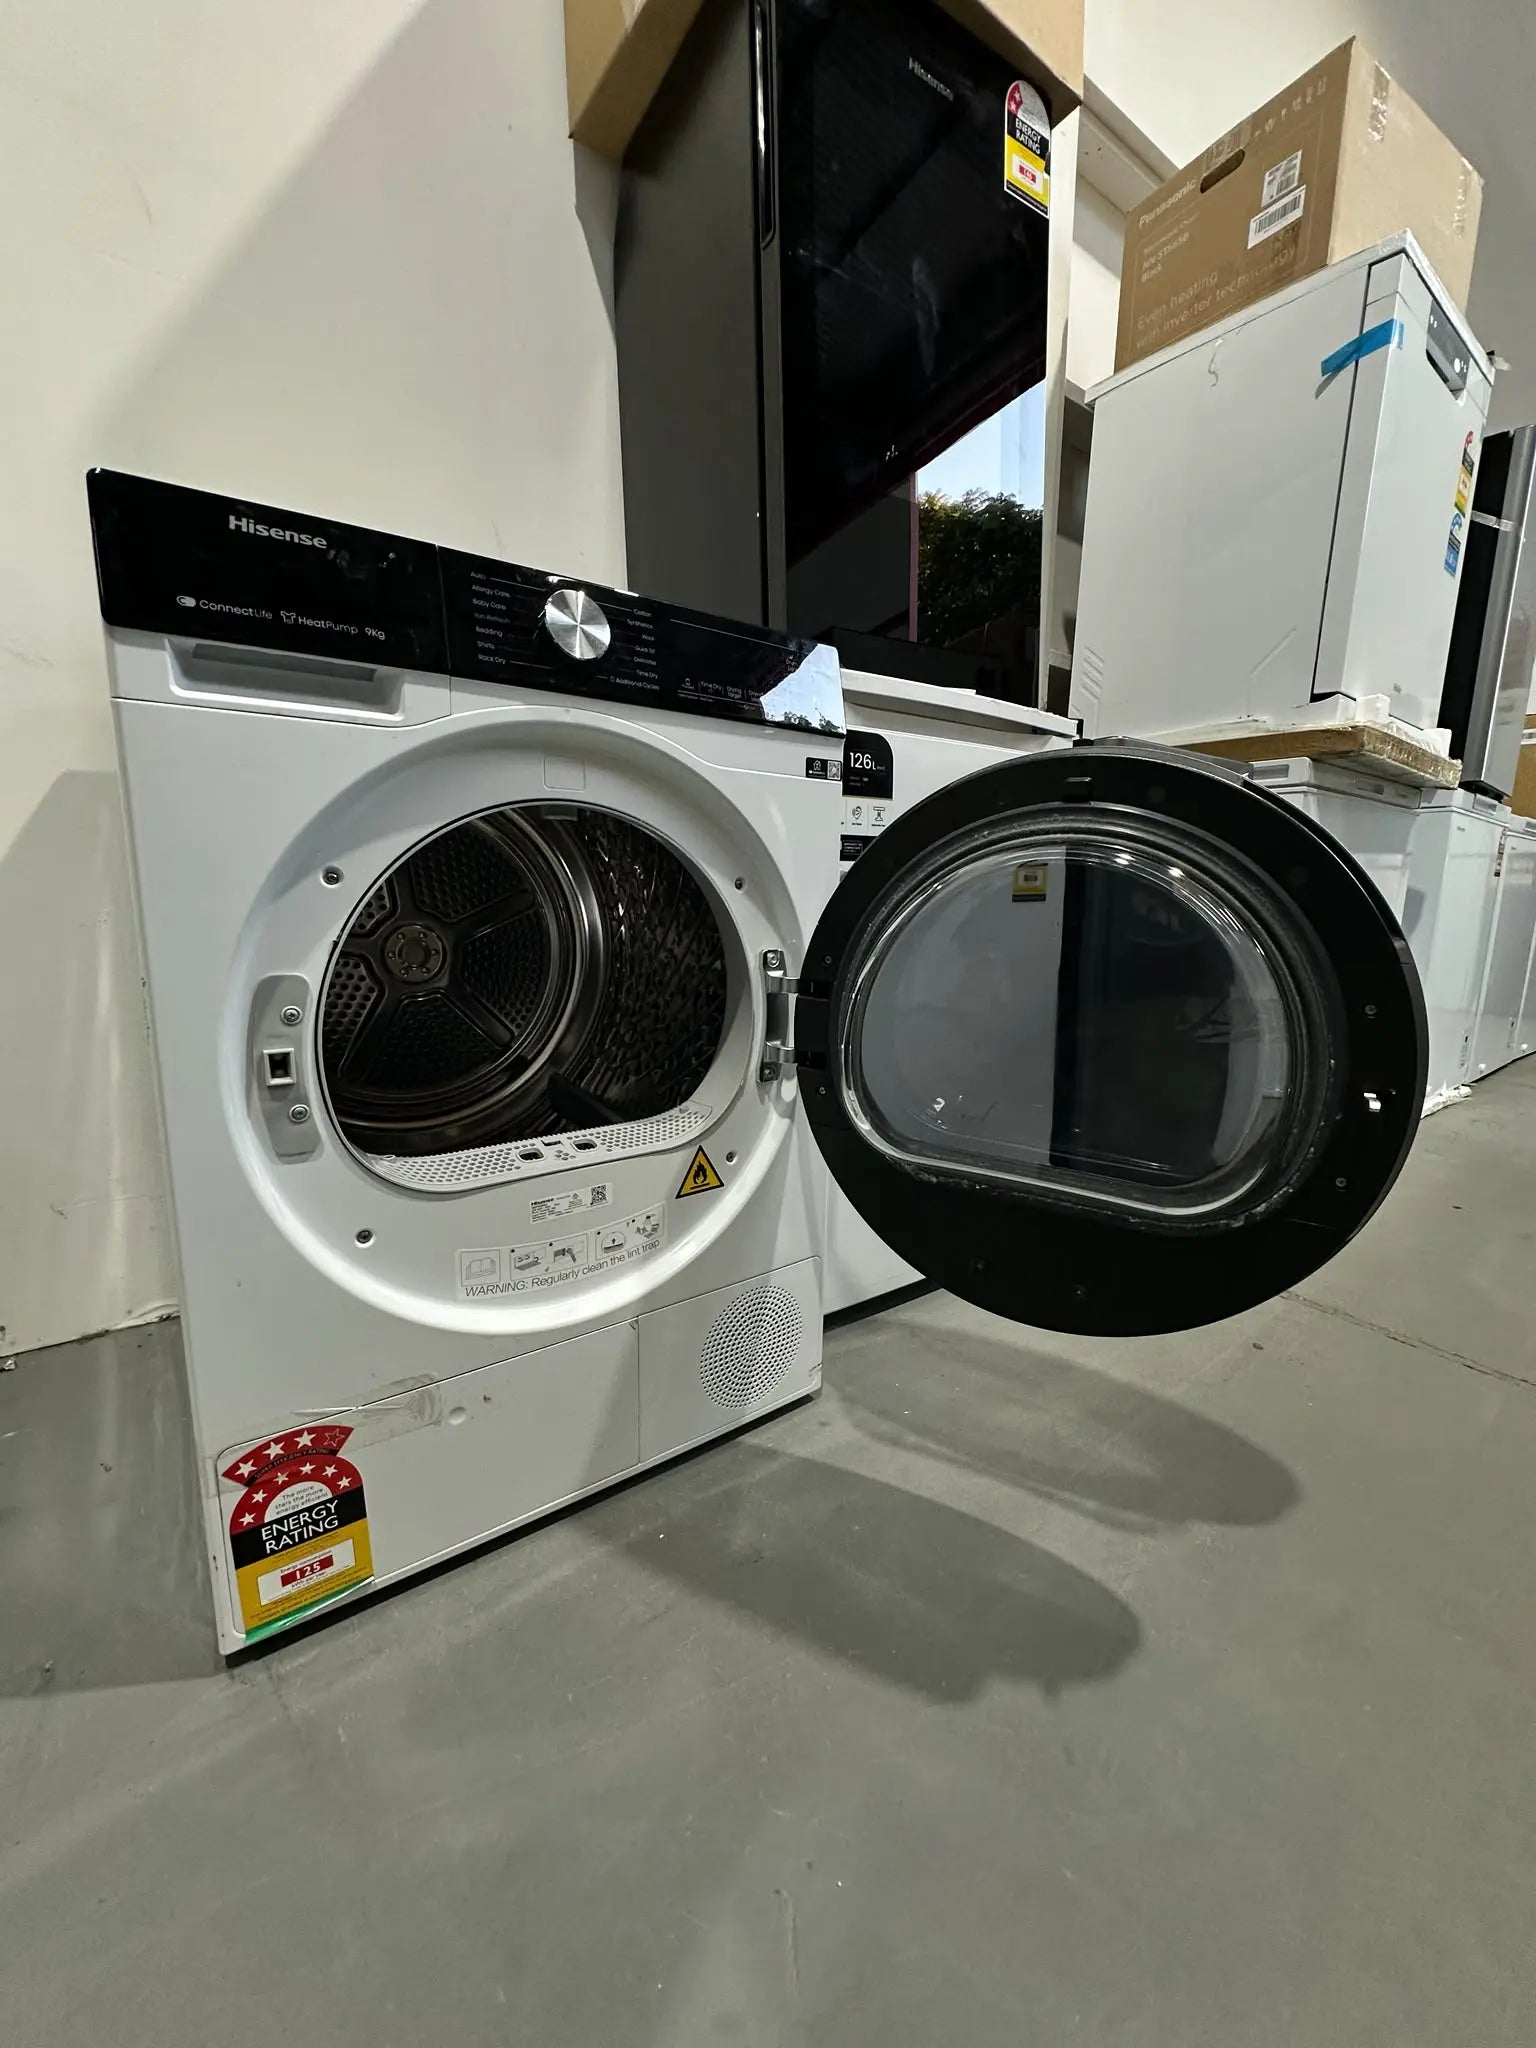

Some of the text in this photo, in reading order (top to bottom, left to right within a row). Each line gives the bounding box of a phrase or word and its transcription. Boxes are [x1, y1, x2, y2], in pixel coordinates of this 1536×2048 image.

[909, 56, 954, 101] Hisense
[1015, 117, 1042, 145] ENERGY
[1015, 129, 1041, 155] RATING
[1138, 178, 1197, 230] Panasonic
[1137, 270, 1218, 330] Even heating
[1163, 295, 1213, 331] inverter
[1215, 247, 1297, 301] technology
[228, 515, 328, 549] Hisense
[199, 600, 273, 620] ConnectLife
[297, 615, 386, 641] HeatPump 9Kg
[465, 1238, 660, 1298] WARNING: Regularly clean the lint trap
[275, 1488, 324, 1510] stars the more
[282, 1485, 315, 1501] The more
[261, 1500, 339, 1541] ENERGY
[275, 1504, 300, 1516] energy
[265, 1515, 340, 1554] RATING
[295, 1562, 321, 1580] 125
